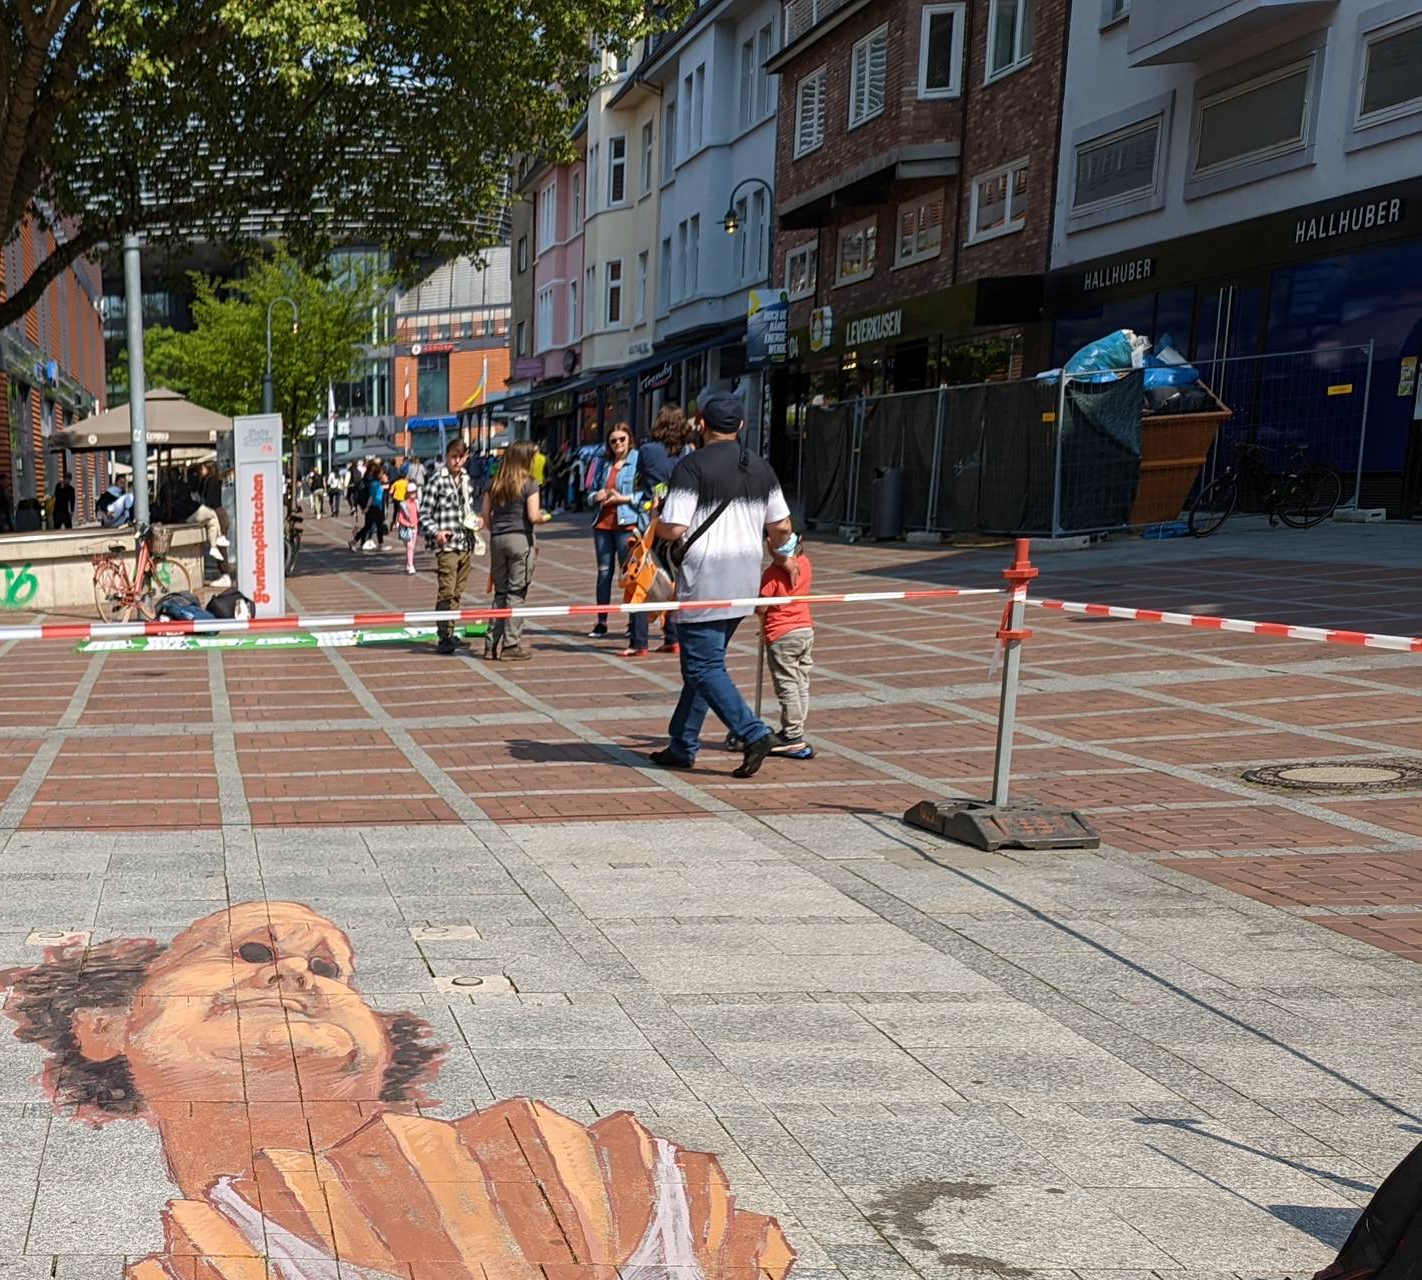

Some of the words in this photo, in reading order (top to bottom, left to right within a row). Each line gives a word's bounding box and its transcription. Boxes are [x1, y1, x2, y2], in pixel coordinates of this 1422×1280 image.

[1295, 198, 1401, 245] HALLHUBER
[1084, 258, 1151, 291] HALLHUBER
[845, 309, 902, 347] LEVERKUSEN
[251, 473, 271, 604] Funkenplätzchen
